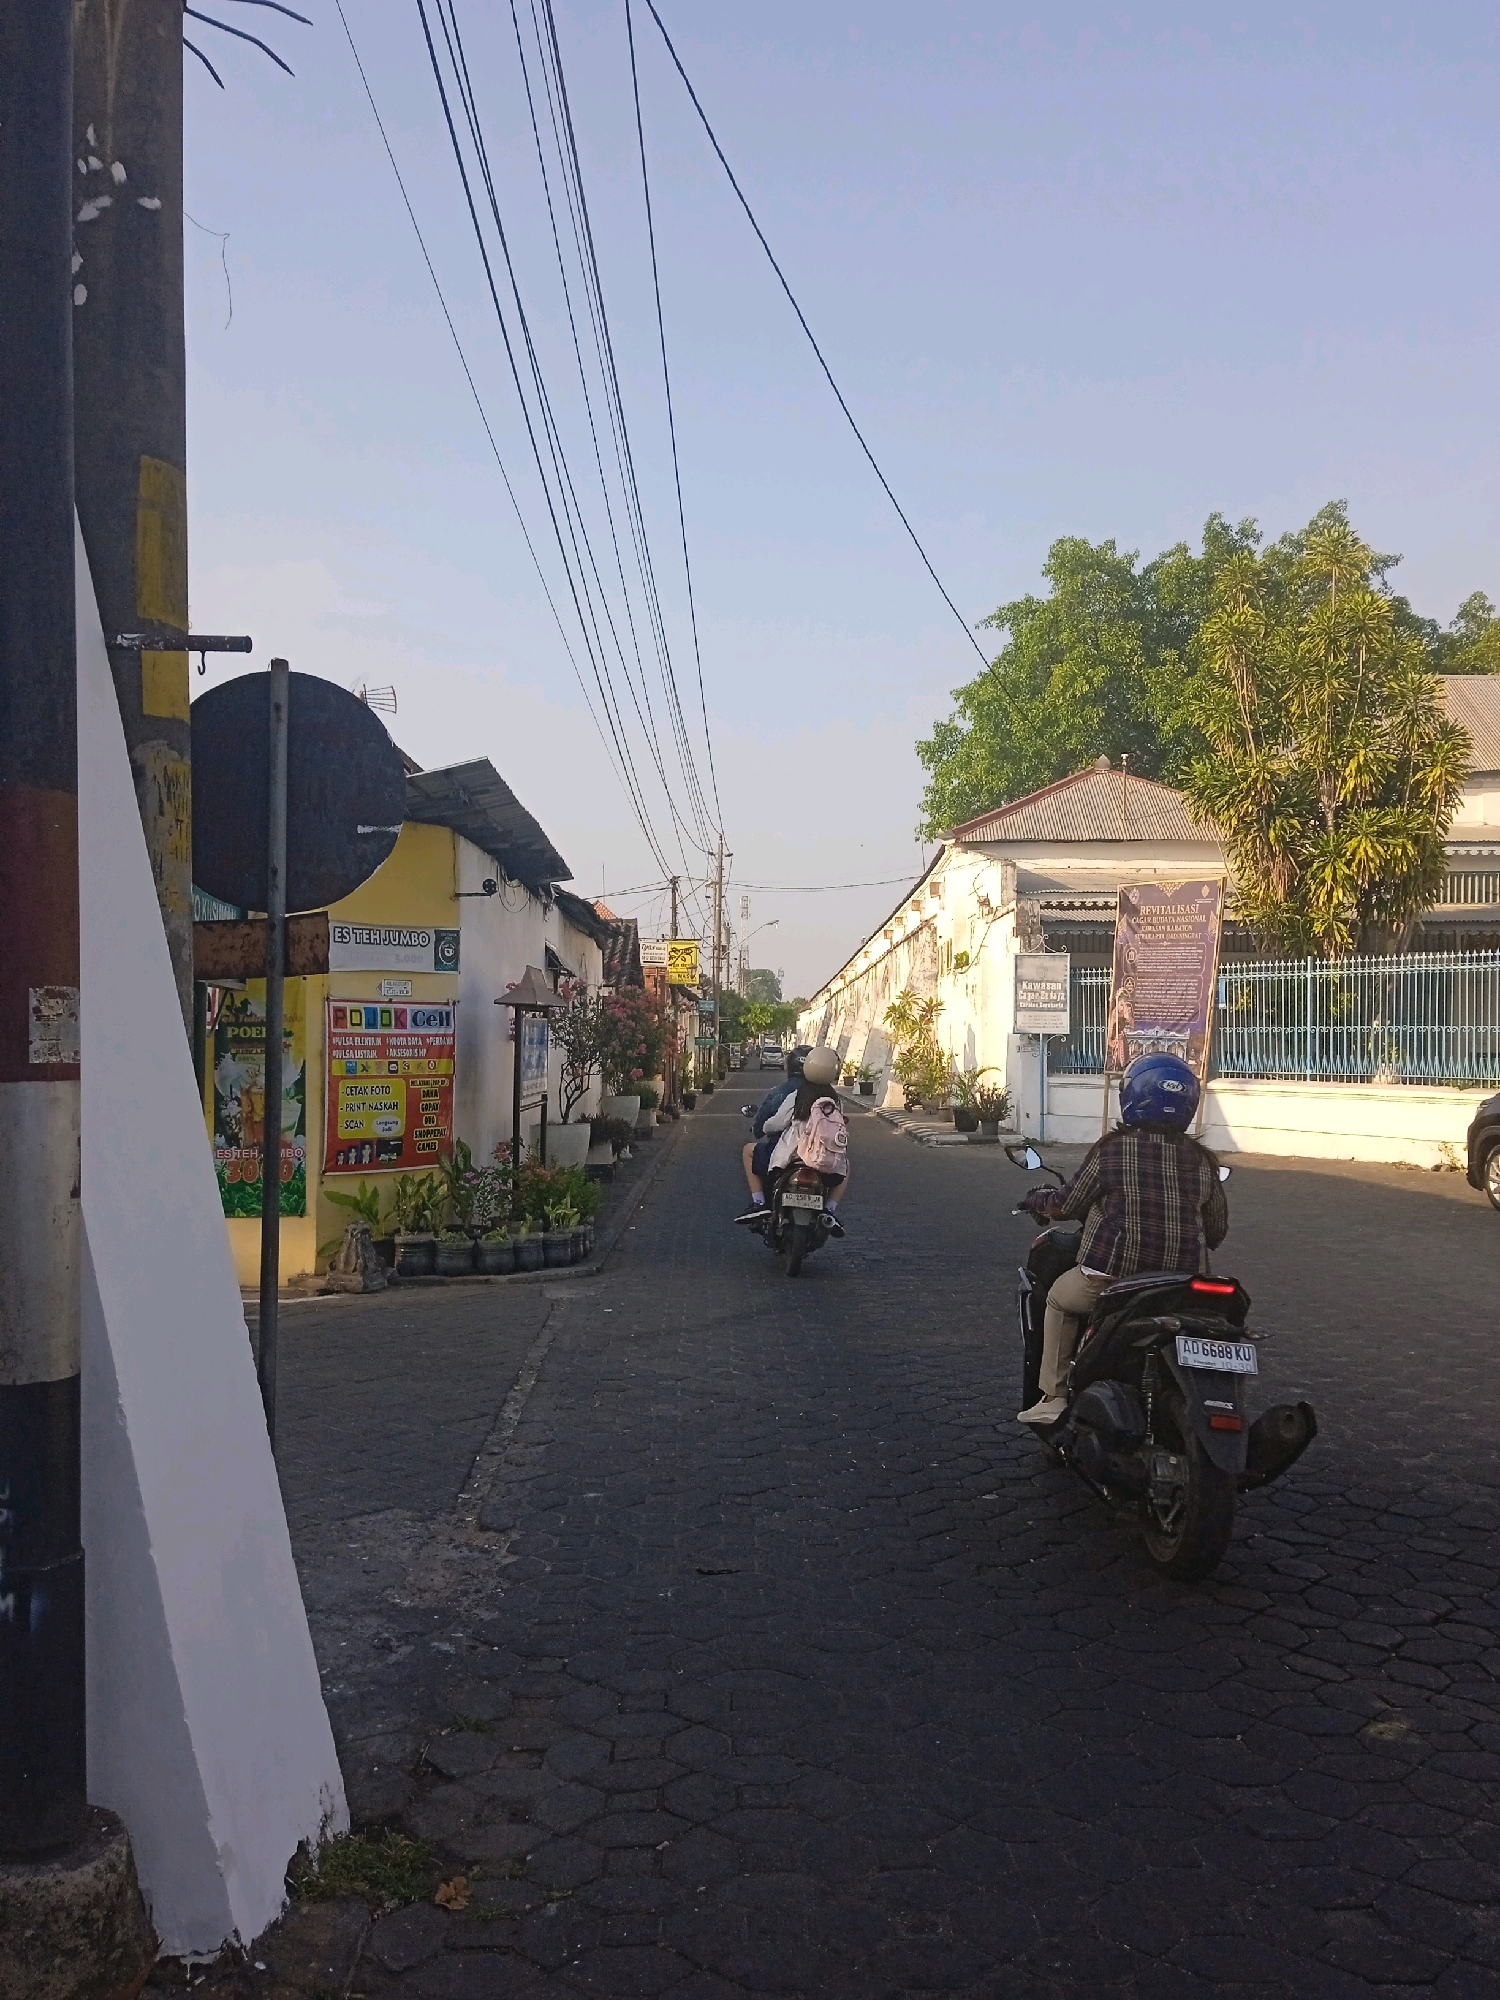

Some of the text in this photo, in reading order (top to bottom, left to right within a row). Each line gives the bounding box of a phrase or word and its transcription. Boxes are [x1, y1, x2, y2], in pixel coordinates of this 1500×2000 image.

[1140, 904, 1200, 915] REVITALISASI
[1176, 915, 1206, 923] NASIONAL
[333, 926, 350, 944] ES
[352, 927, 381, 945] TEH
[382, 929, 430, 948] JUMBO
[1022, 981, 1062, 990] Kawasan
[334, 1008, 451, 1028] POJOK Cell
[345, 1085, 368, 1097] CETAK
[370, 1085, 391, 1096] FOTO
[422, 1089, 438, 1099] DANA
[345, 1102, 366, 1112] PRINT
[368, 1101, 399, 1112] NASKAH
[421, 1102, 439, 1113] GOPAY
[344, 1120, 365, 1130] SCAN
[417, 1141, 437, 1152] GAMES
[216, 1149, 232, 1159] ES
[234, 1148, 258, 1158] TEH
[226, 1159, 294, 1184] 300
[1183, 1340, 1251, 1361] AD 6688 KU
